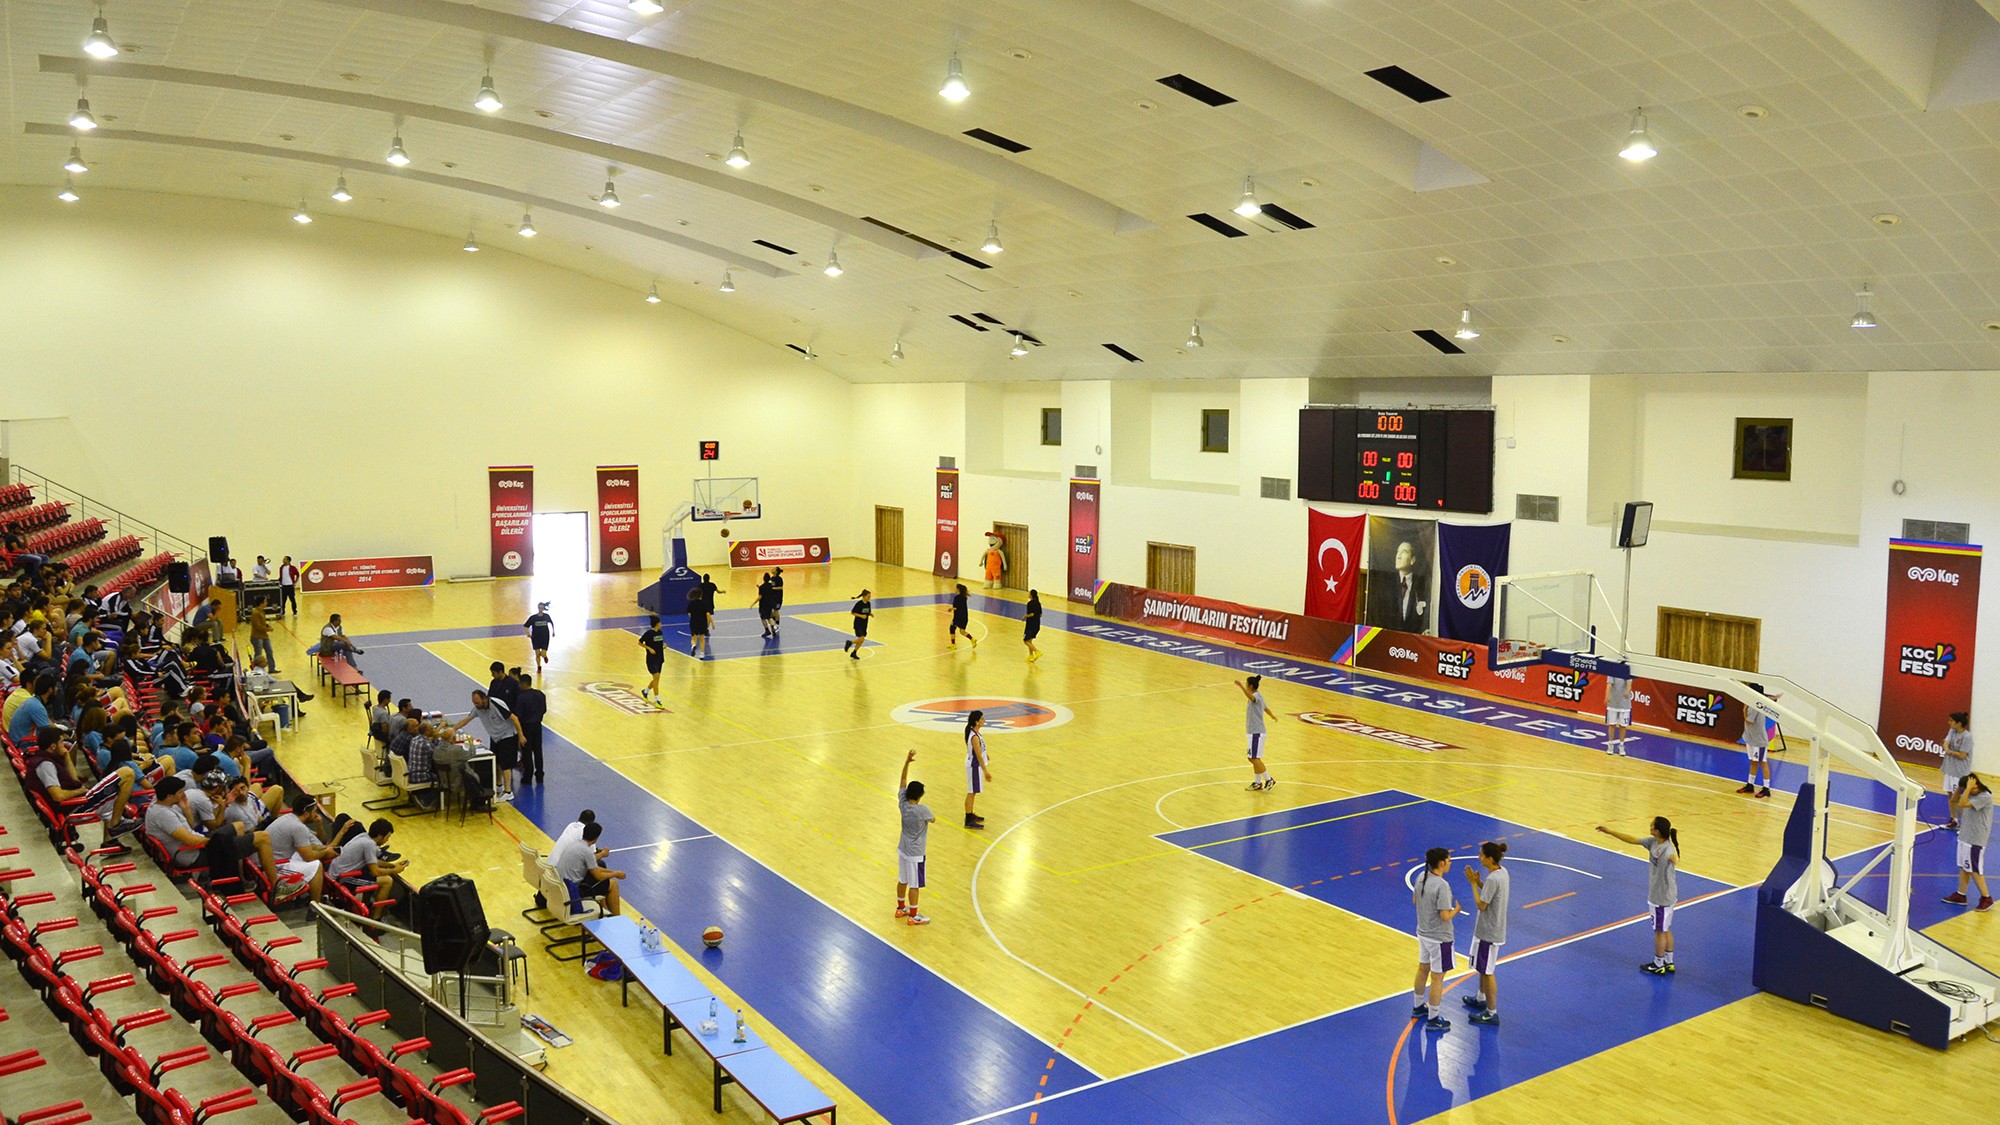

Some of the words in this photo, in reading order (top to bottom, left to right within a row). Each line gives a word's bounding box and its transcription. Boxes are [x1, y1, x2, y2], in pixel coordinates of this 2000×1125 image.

[704, 450, 714, 458] 24
[1363, 451, 1378, 466] 00
[1397, 452, 1413, 468] 00
[1358, 482, 1380, 498] 000
[1394, 484, 1416, 502] 000
[495, 519, 528, 528] BAŞARILAR
[604, 516, 635, 524] BAŞARILAR
[500, 526, 524, 535] DİLERİZ
[608, 524, 630, 532] DİLERİZ
[1075, 537, 1087, 545] KOÇ
[1075, 544, 1091, 554] FEST
[1938, 569, 1959, 586] Koç
[1143, 598, 1228, 628] ŞAMPİYONLARIN
[1229, 615, 1289, 640] FESTİVALİ
[1073, 624, 1225, 657] MERSİN
[1406, 650, 1418, 662] Koç
[1438, 652, 1462, 665] KOÇ
[1902, 646, 1935, 662] KOÇ
[1438, 664, 1470, 679] FEST
[1570, 661, 1597, 670] Sports
[1900, 660, 1947, 678] FEST
[1549, 672, 1573, 686] KOÇ
[1547, 684, 1582, 701] FEST
[1634, 690, 1651, 706] Koç
[1678, 695, 1707, 710] KOÇ
[1676, 708, 1718, 726] FEST
[1925, 740, 1946, 757] Koç
[1964, 859, 1970, 869] 5
